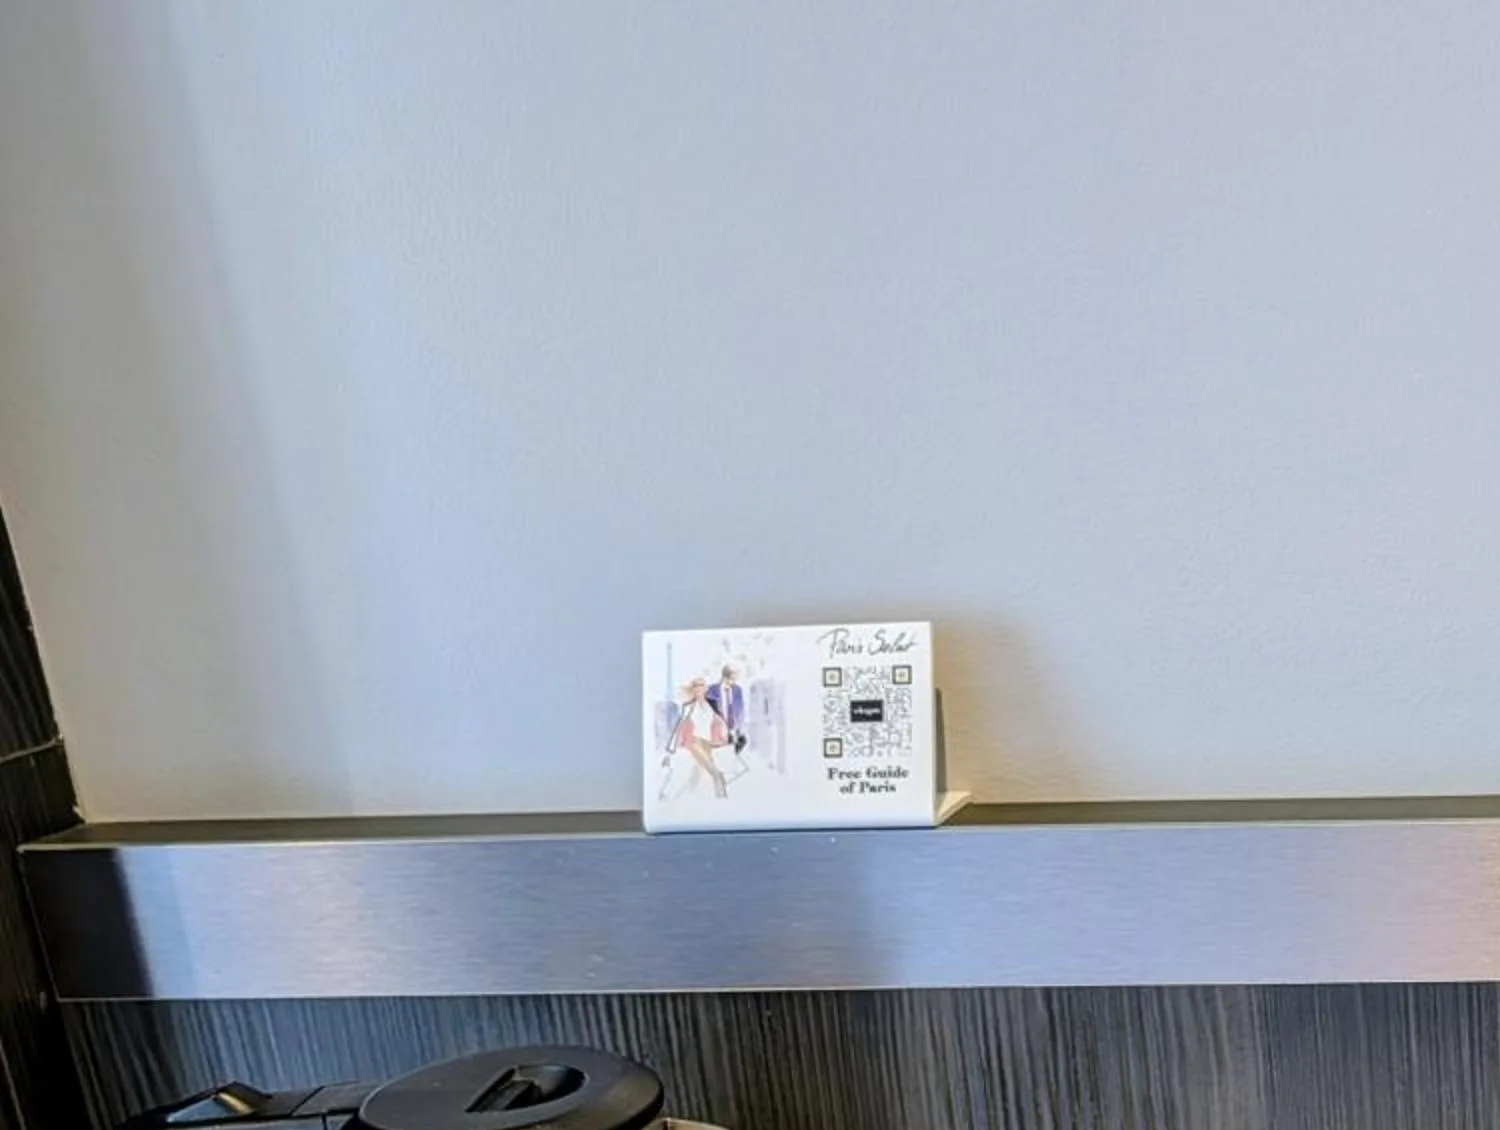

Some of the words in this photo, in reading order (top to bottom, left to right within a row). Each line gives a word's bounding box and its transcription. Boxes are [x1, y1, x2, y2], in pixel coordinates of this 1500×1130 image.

[816, 627, 863, 659] Paris
[826, 767, 862, 780] Free
[865, 765, 909, 779] Guide
[839, 781, 856, 794] of
[859, 780, 897, 793] Paris
